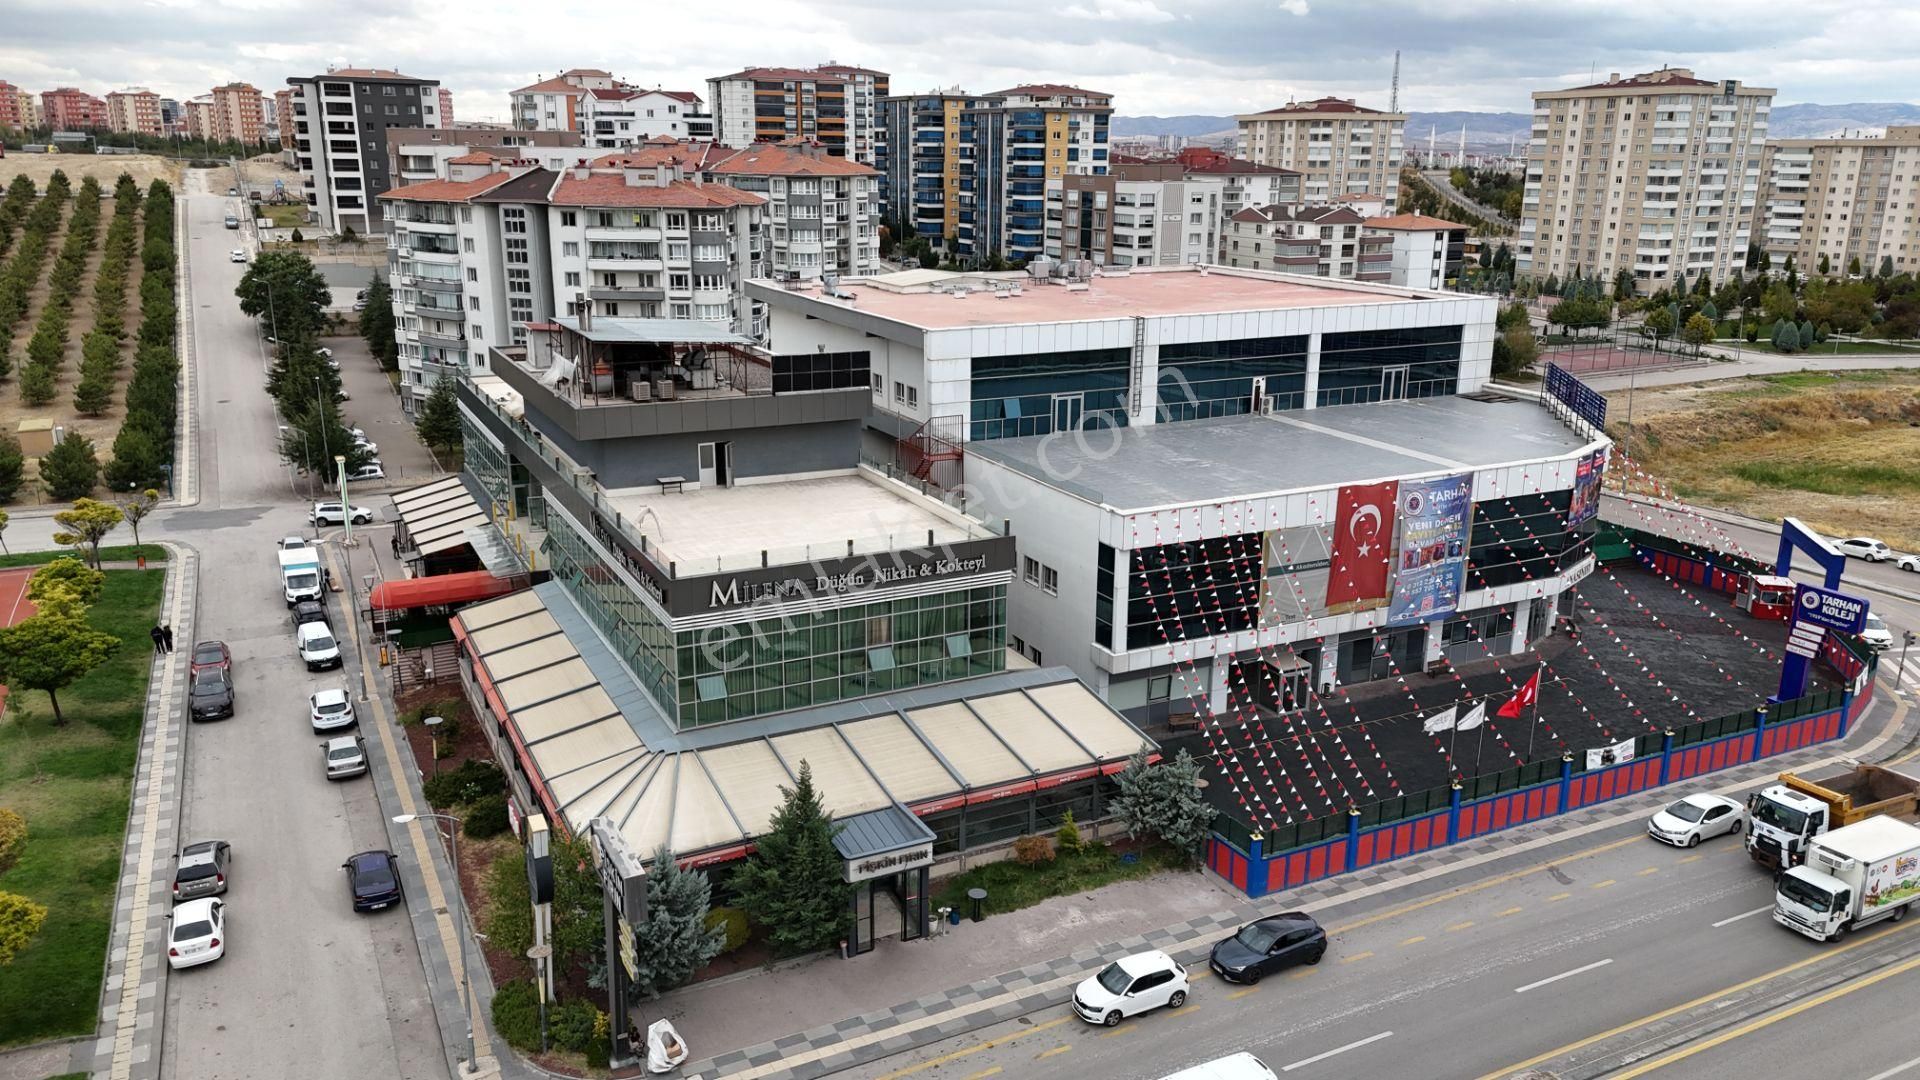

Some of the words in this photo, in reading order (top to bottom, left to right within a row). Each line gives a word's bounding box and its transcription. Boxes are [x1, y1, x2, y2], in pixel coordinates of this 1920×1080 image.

[816, 574, 864, 592] Düğün
[874, 564, 916, 584] Nikah
[919, 564, 932, 577] &
[935, 554, 986, 577] Kokteyl
[1821, 594, 1861, 613] TARHAN
